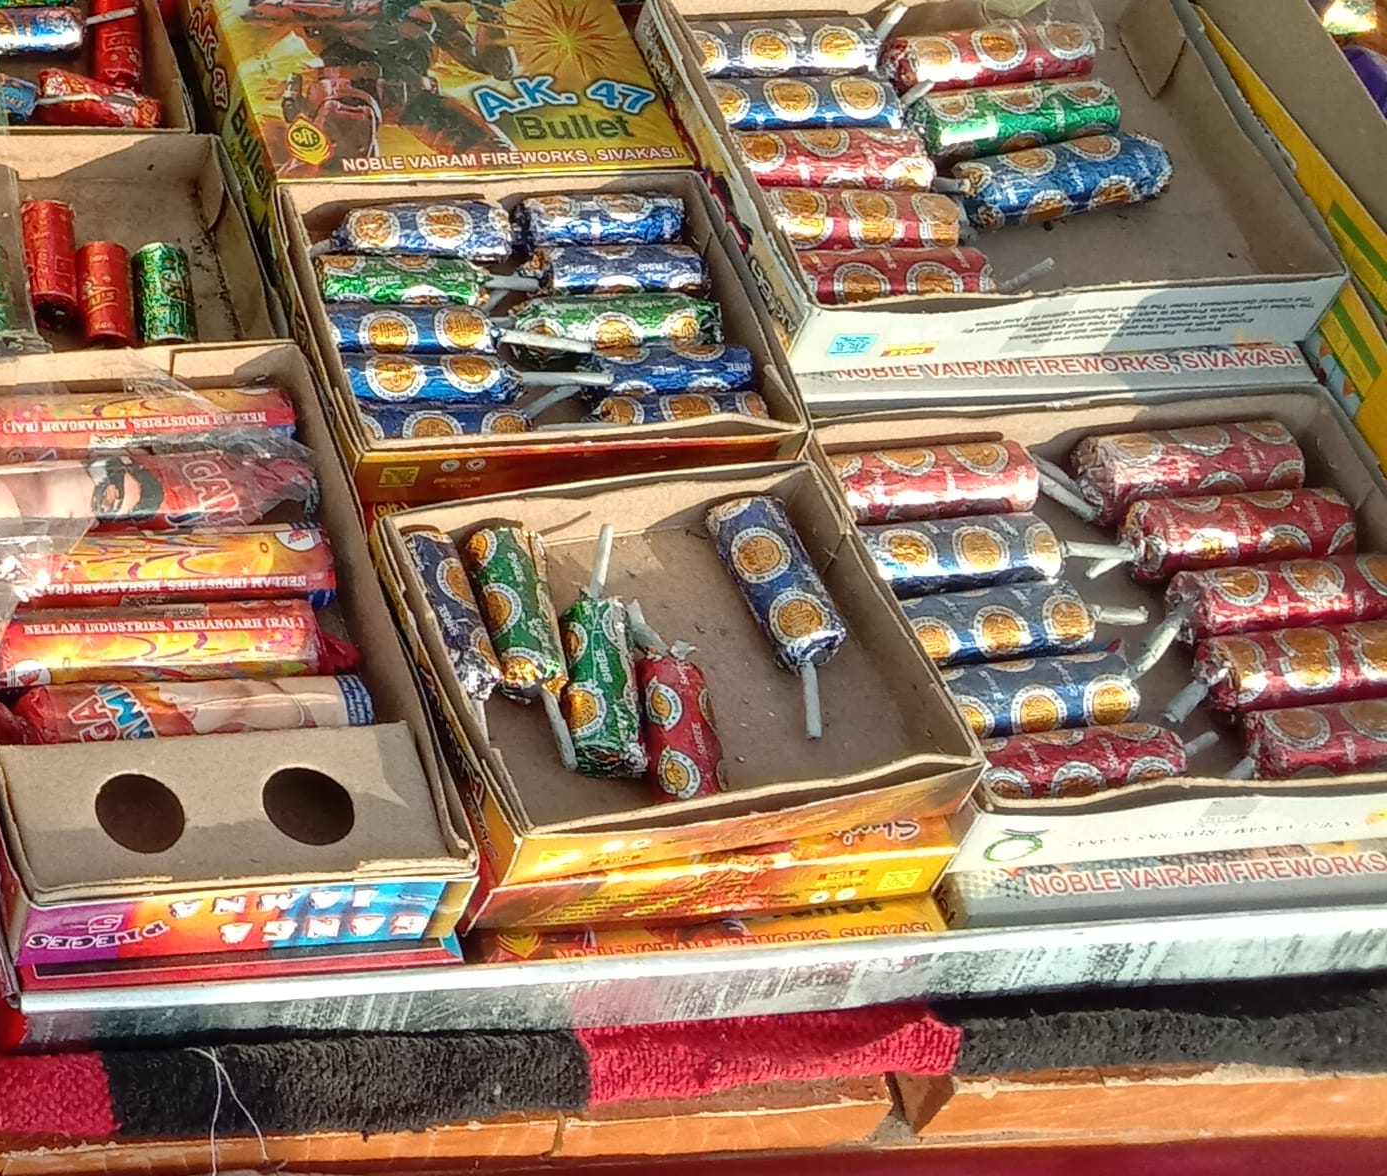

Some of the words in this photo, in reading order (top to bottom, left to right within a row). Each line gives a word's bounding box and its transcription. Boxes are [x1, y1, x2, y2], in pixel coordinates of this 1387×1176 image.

[473, 76, 579, 120] A.K.
[513, 112, 635, 144] Bullet
[229, 99, 273, 196] Bullet
[341, 154, 406, 174] NOBLE
[407, 152, 478, 170] VAIRAM
[480, 148, 594, 168] FIREWORKS,
[596, 144, 684, 164] SIVAKASI.
[833, 360, 925, 380] NOBLE
[927, 357, 1023, 380] VAIRAM
[1023, 351, 1180, 378] FIREWORKS,
[39, 417, 126, 433] KISHANGARH
[71, 580, 160, 595] KISHANGARH
[248, 574, 307, 589] NEELAM
[23, 620, 84, 635] NEELAM
[85, 619, 172, 634] INDUSTRIES,
[172, 617, 263, 631] KISHANGARH
[1028, 870, 1125, 898] NOBLE
[1125, 864, 1225, 892] VAIRAM
[26, 920, 169, 949] PIECES
[86, 912, 124, 933] 5
